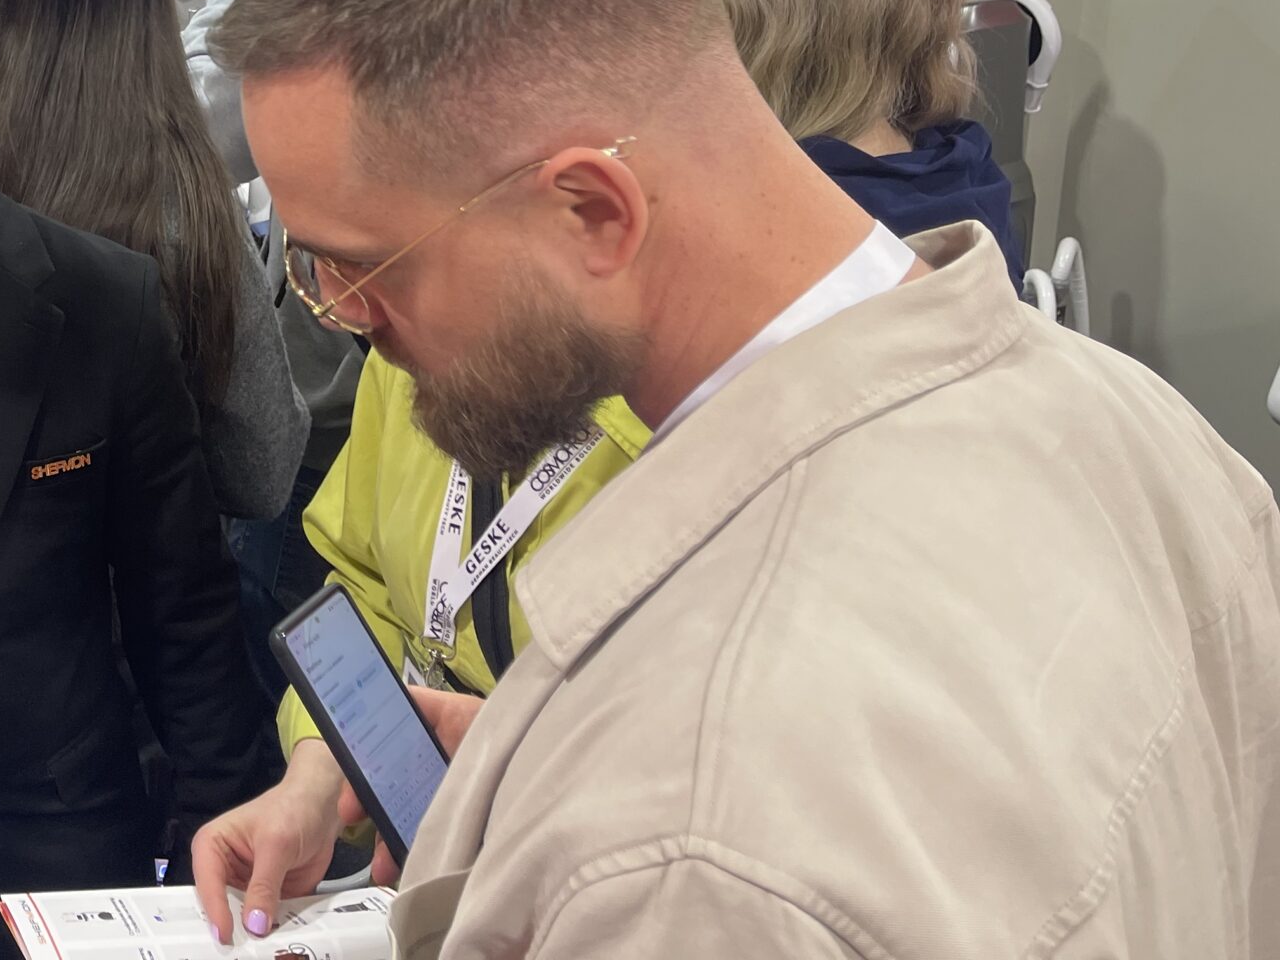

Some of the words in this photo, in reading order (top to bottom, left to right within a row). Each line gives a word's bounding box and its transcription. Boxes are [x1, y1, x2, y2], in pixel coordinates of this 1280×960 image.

[540, 463, 575, 500] WORLDWIDE
[575, 432, 604, 463] BOLOGNA
[448, 473, 467, 535] ESKE
[465, 518, 511, 574] GESKE
[506, 529, 519, 543] TECH
